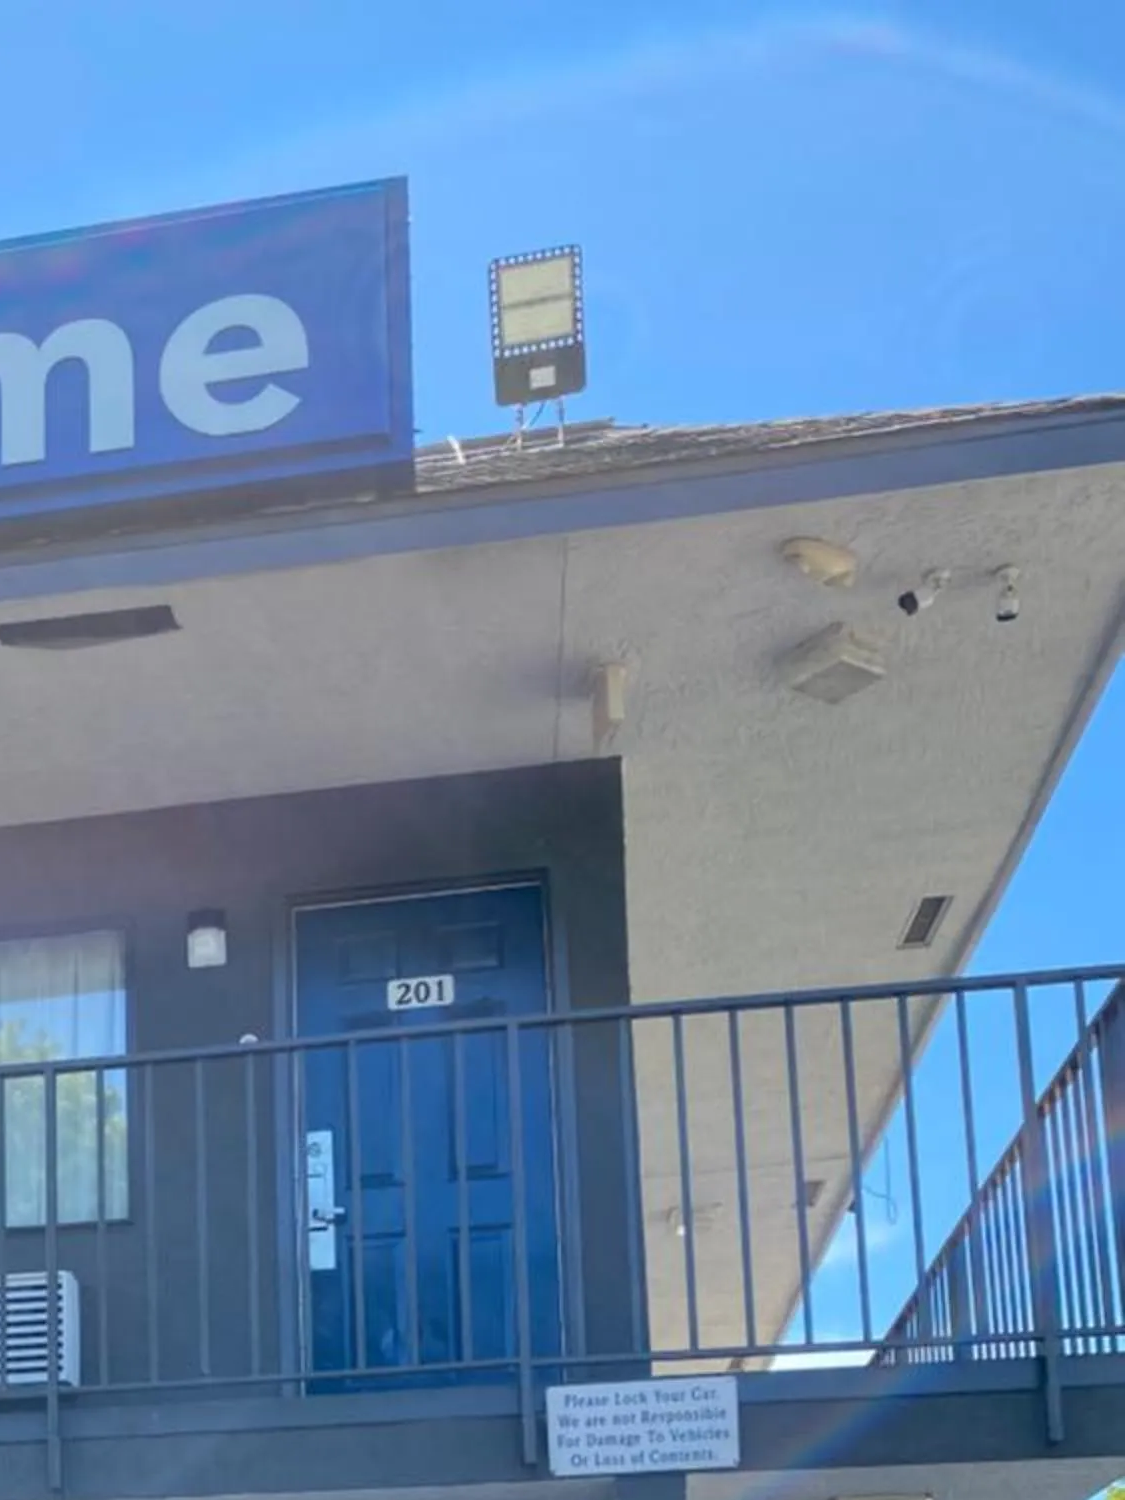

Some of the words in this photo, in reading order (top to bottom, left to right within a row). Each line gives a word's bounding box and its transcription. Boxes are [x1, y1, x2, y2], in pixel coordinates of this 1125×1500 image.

[395, 980, 444, 1005] 201
[564, 1393, 609, 1409] Please
[614, 1391, 648, 1406] Lock
[654, 1389, 686, 1403] Your
[557, 1415, 580, 1429] We
[585, 1414, 606, 1427] are
[613, 1411, 636, 1426] not
[640, 1408, 727, 1425] Responsible
[557, 1434, 580, 1448] For
[586, 1431, 641, 1448] Damage
[647, 1430, 665, 1444] To
[669, 1426, 730, 1442] Vehicles
[570, 1453, 588, 1467] Or
[594, 1452, 625, 1466] Loss
[631, 1451, 645, 1464] of
